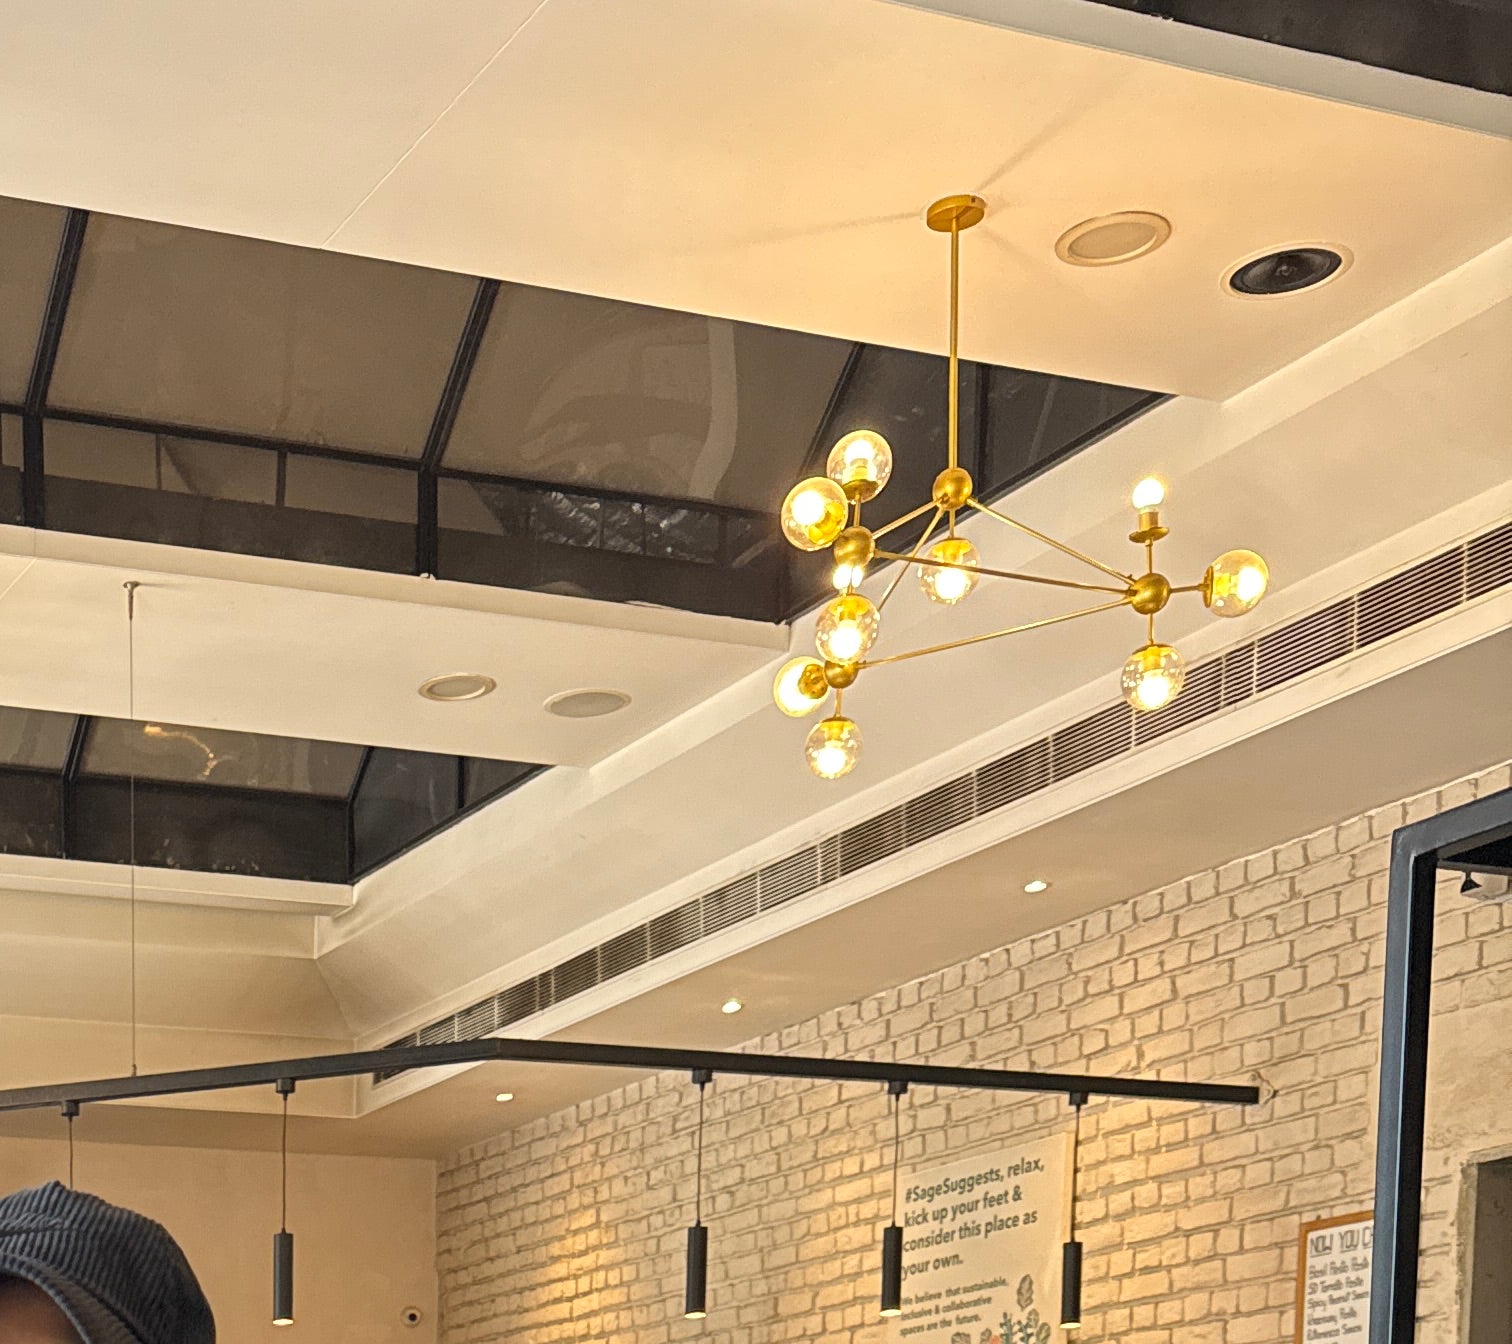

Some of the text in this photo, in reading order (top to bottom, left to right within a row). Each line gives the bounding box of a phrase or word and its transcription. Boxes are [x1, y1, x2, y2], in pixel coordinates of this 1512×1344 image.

[905, 1157, 1045, 1203] #SageSuggests, relax,
[904, 1185, 1023, 1227] kick up your feet &
[903, 1210, 1038, 1252] consider this place as
[1310, 1233, 1334, 1253] NOW
[1338, 1229, 1360, 1250] YOU
[901, 1253, 964, 1281] your own.
